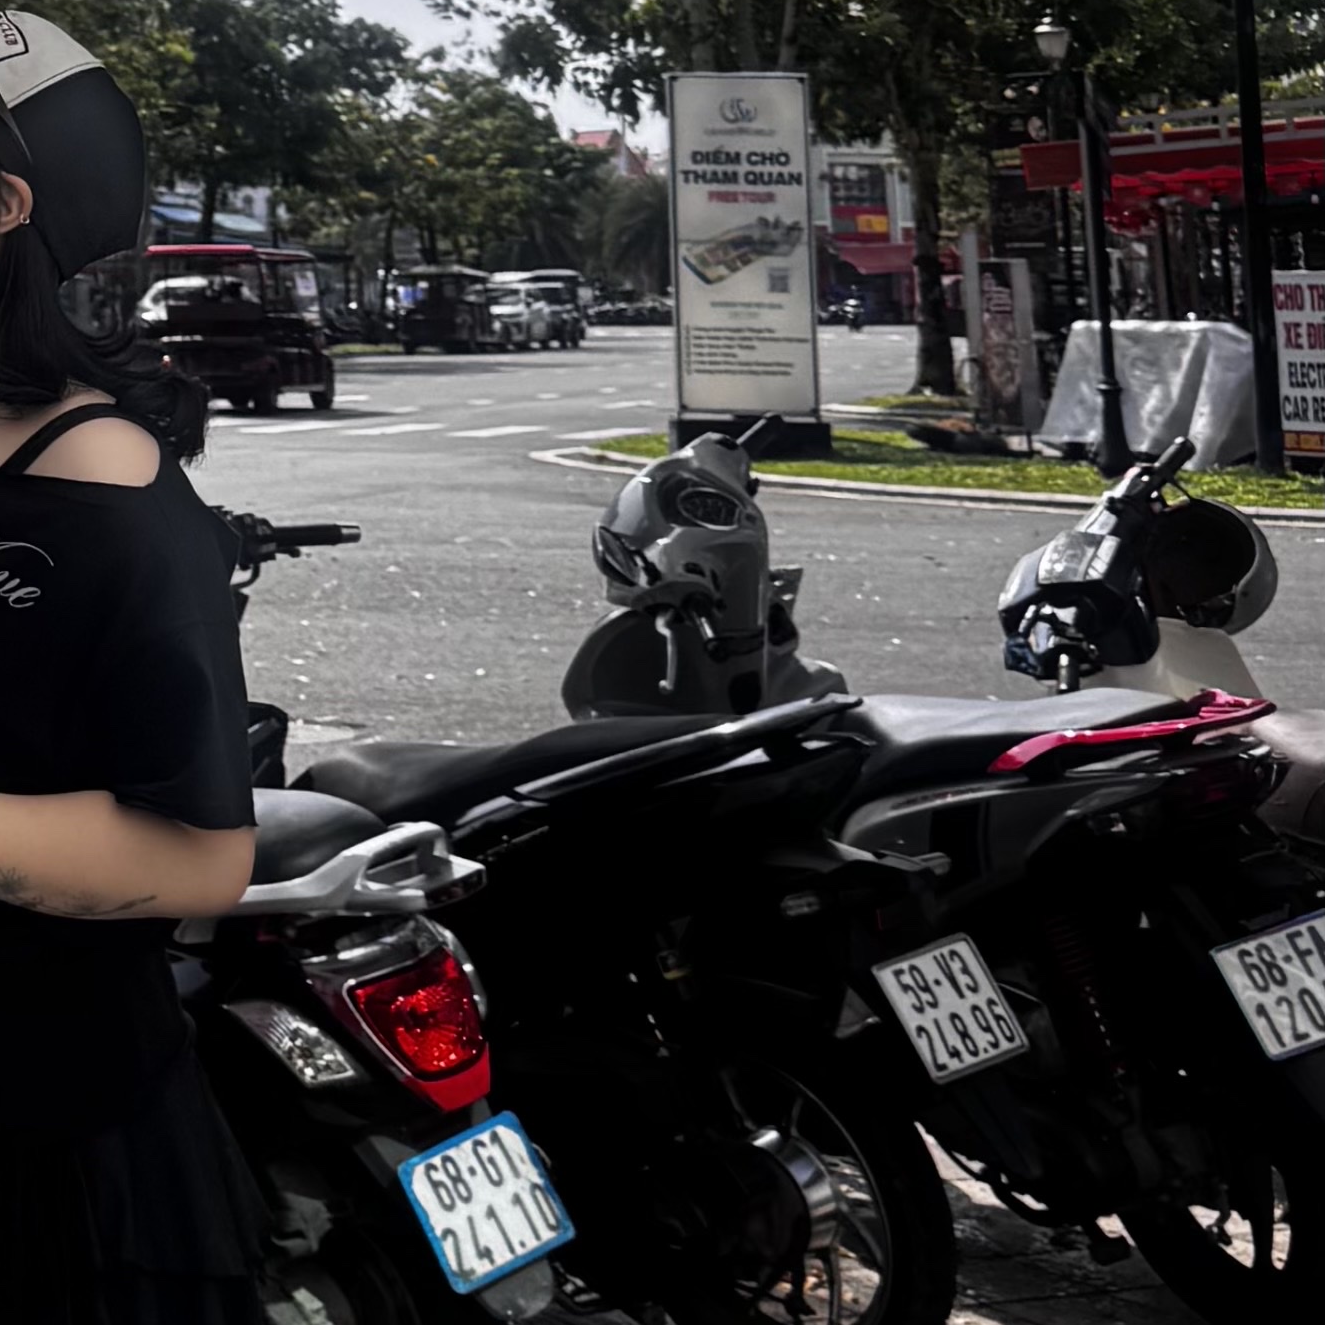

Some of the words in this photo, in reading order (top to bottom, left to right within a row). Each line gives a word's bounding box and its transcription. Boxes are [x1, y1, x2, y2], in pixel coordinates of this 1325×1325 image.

[743, 169, 804, 187] QUAN
[1272, 283, 1304, 311] CHO
[1282, 321, 1304, 350] XE
[1287, 360, 1325, 389] ELECT
[1281, 395, 1311, 423] CAR
[915, 996, 1017, 1073] 248.96
[440, 1181, 560, 1283] 241.10
